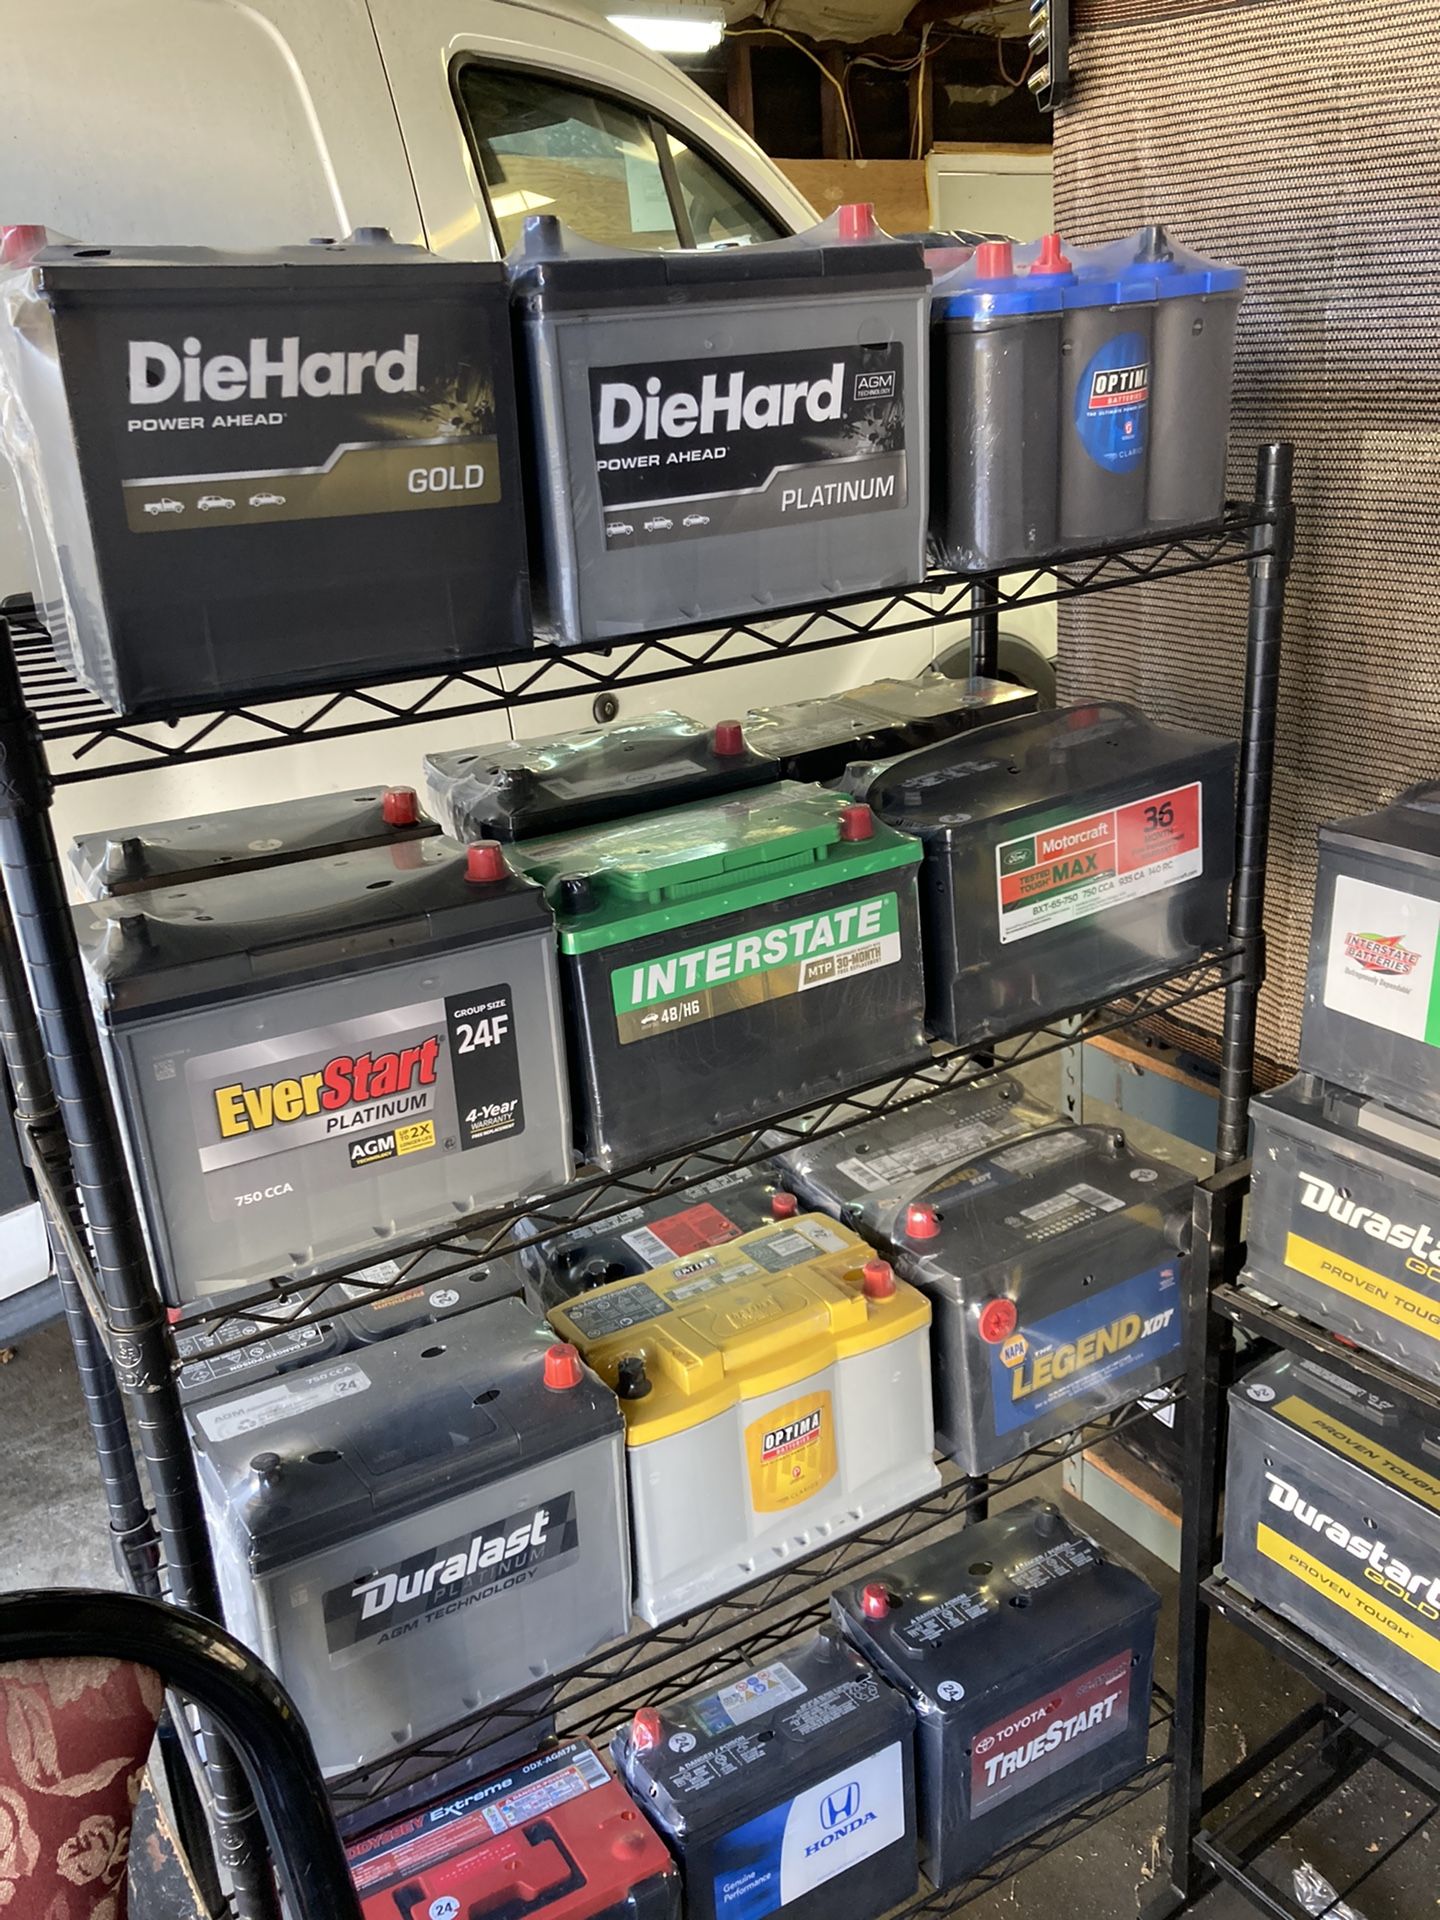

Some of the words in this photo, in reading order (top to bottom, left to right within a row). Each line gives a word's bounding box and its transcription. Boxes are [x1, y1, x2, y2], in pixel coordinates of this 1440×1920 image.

[129, 334, 419, 404] DieHard
[857, 373, 893, 389] AGM
[599, 363, 846, 444] DieHard
[857, 387, 891, 397] TECHNOLOGY
[128, 417, 205, 431] POWER
[212, 412, 284, 428] AHEAD
[597, 454, 660, 472] POWER
[666, 447, 727, 465] AHEAD
[408, 465, 484, 493] GOLD
[781, 475, 895, 512] PLATINUM
[1144, 801, 1174, 832] 36
[1042, 822, 1109, 854] Motorcraft
[1020, 869, 1050, 885] TESTED
[1051, 854, 1098, 883] MAX
[1020, 879, 1049, 893] TOUGH
[1032, 893, 1079, 916] BXT-65-750
[1082, 886, 1098, 899] 750
[1098, 881, 1115, 893] CCA
[1133, 870, 1145, 881] CA
[1162, 860, 1174, 871] RC
[631, 900, 883, 1005] INTERSTATE
[837, 946, 881, 970] 30-MONTH
[1348, 946, 1411, 973] BATTERIES
[1349, 935, 1417, 964] INTERSTATE
[807, 961, 833, 979] MTP
[453, 1003, 486, 1018] GROUP
[486, 999, 507, 1011] SIZE
[660, 999, 700, 1024] 48/H6
[456, 1014, 509, 1055] 24F
[214, 1034, 440, 1139] EverStart
[326, 1093, 428, 1134] PLATINUM
[465, 1099, 518, 1124] 4-Year
[470, 1111, 514, 1130] WARRANTY
[410, 1122, 431, 1138] 2X
[351, 1135, 395, 1160] AGM
[356, 1151, 392, 1165] TECHNOLOGY
[234, 1190, 263, 1207] 750
[264, 1182, 294, 1199] CCA
[1320, 1260, 1389, 1299] PROVEN
[1141, 1308, 1175, 1339] XDT
[1004, 1342, 1024, 1360] NAPA
[1012, 1312, 1141, 1400] LEGEND
[329, 1365, 352, 1378] CCA
[337, 1378, 358, 1393] 24
[765, 1412, 820, 1450] OPTIMA
[1311, 1419, 1380, 1460] PROVEN
[1382, 1459, 1440, 1498] TOUGH
[352, 1508, 550, 1621] Duralast
[434, 1546, 546, 1604] PLATINUM
[377, 1618, 419, 1646] AGM
[425, 1567, 538, 1624] TECHNOLOGY
[1288, 1554, 1352, 1599] PROVEN
[1355, 1597, 1410, 1639] TOUGH
[1362, 1566, 1440, 1622] GOLD
[996, 1707, 1048, 1742] TOYOTA
[522, 1743, 578, 1775] ODX-AGM78
[684, 1751, 716, 1769] DANGER
[430, 1777, 513, 1822] Extreme
[804, 1811, 878, 1858] HONDA
[723, 1870, 756, 1893] Genuine
[723, 1872, 772, 1903] Performance
[435, 1903, 453, 1917] 24
